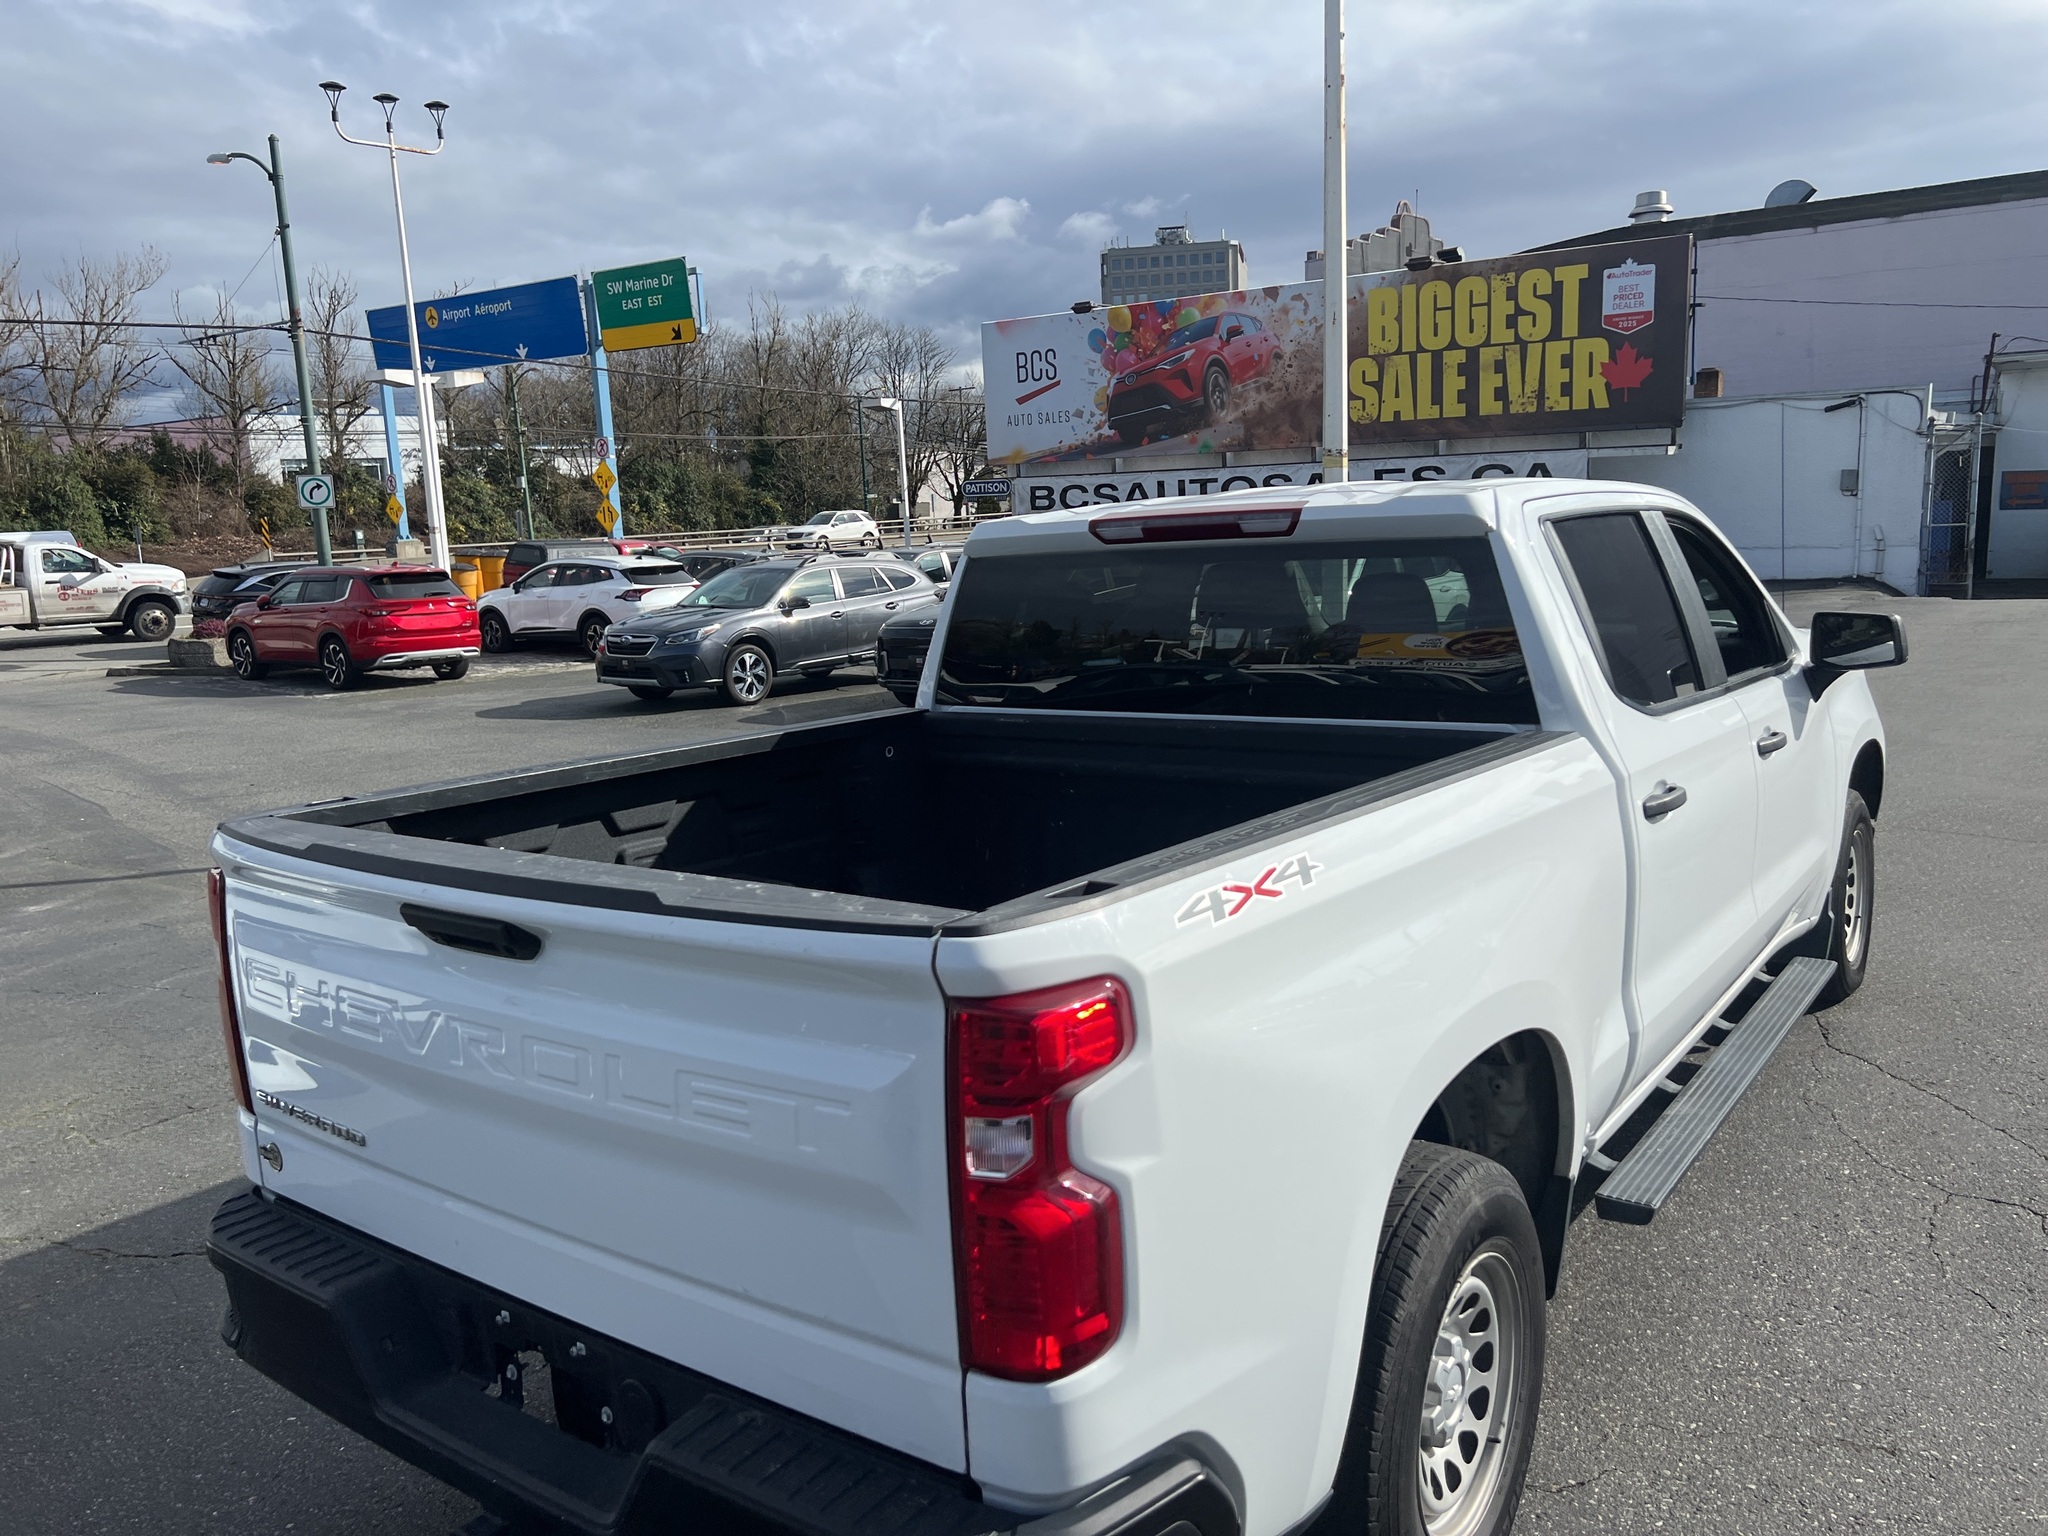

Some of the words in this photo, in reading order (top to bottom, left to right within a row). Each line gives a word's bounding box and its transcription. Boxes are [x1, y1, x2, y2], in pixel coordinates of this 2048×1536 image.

[1611, 269, 1653, 279] AutoTrader
[606, 281, 623, 295] SW
[625, 277, 659, 292] Marine
[661, 274, 674, 287] Dr
[1618, 284, 1640, 293] BEST
[622, 298, 642, 310] EAST
[647, 294, 663, 307] EST
[1612, 300, 1645, 310] DEALER
[1613, 292, 1644, 302] PRICED
[442, 306, 471, 322] Airport
[474, 299, 512, 316] Aéroport
[1367, 263, 1589, 356] BIGGEST
[1618, 320, 1637, 328] 2025
[1016, 348, 1057, 383] BCS
[1349, 349, 1467, 424] SALE
[1479, 337, 1611, 416] EVER
[1007, 413, 1033, 427] AUTO
[1038, 410, 1071, 425] SALES
[965, 483, 1007, 493] PATTISON
[246, 957, 850, 1152] CHEVROLET
